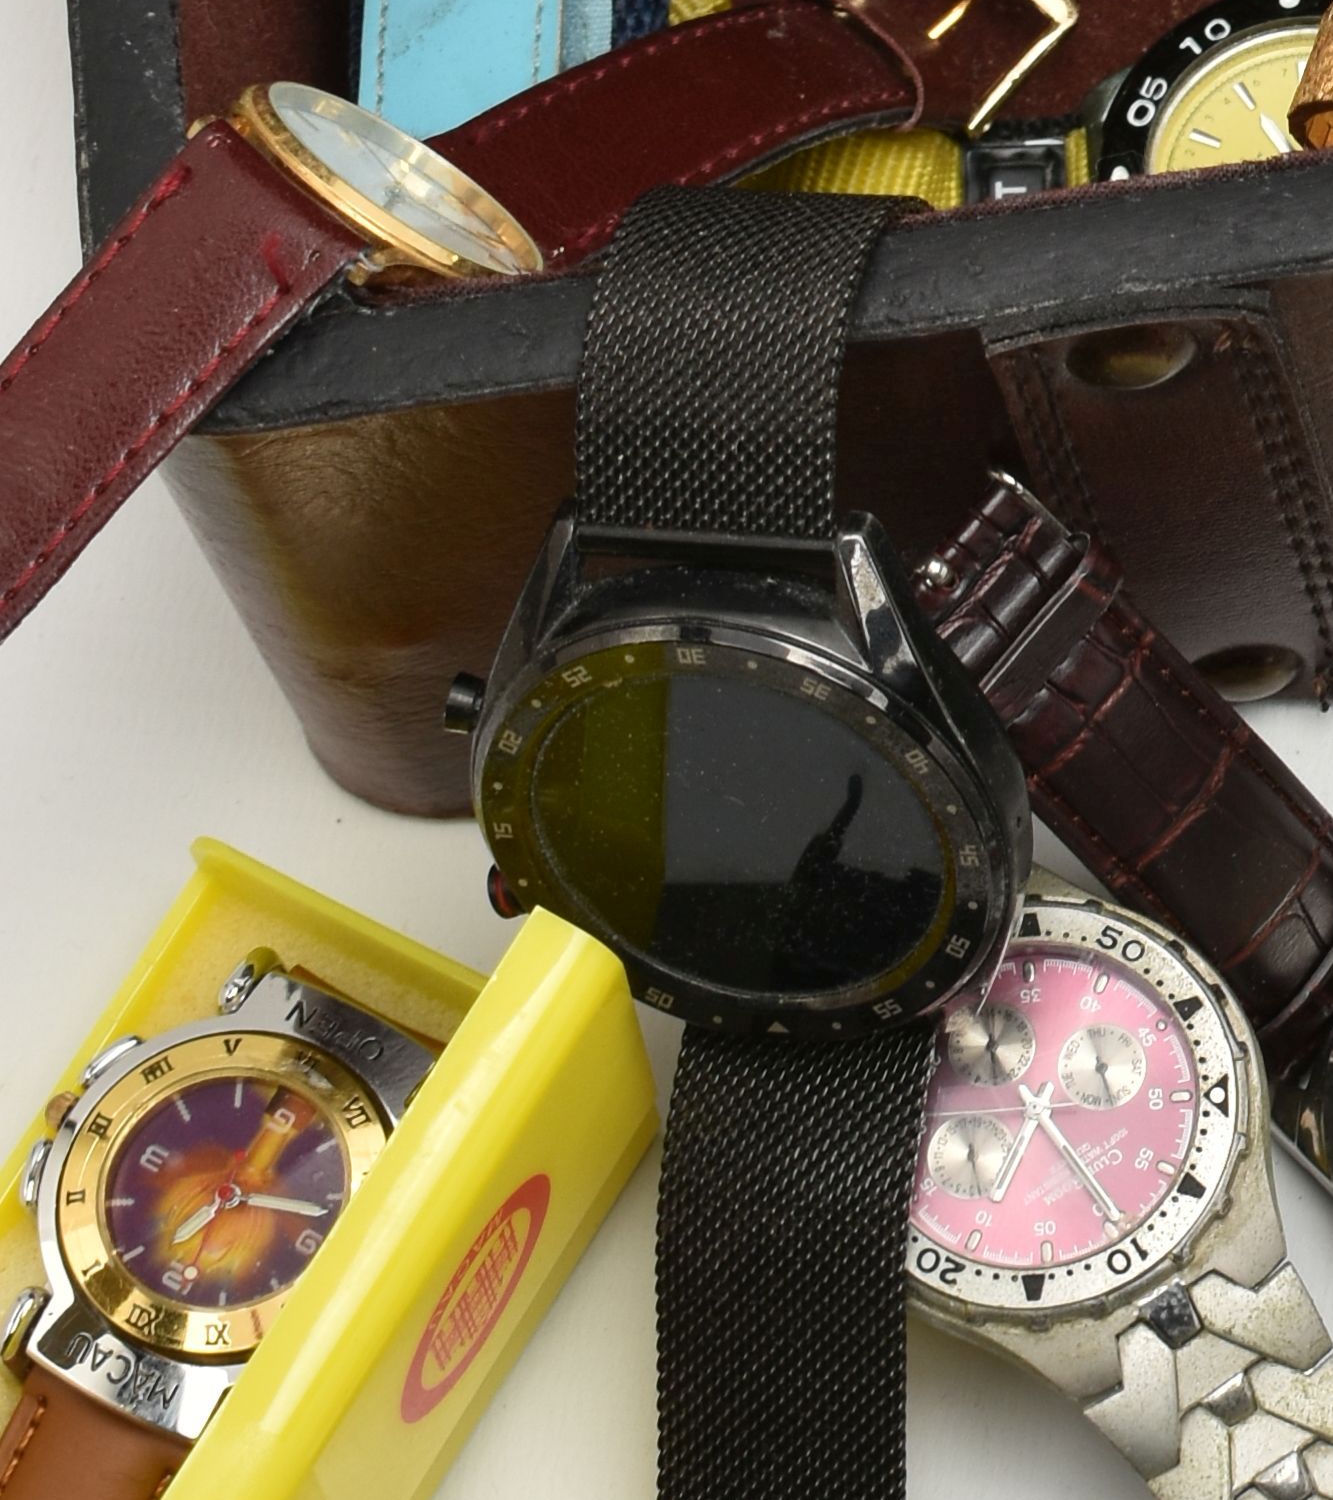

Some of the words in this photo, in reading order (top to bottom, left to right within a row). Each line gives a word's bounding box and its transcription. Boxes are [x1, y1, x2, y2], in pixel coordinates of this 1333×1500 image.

[1179, 18, 1231, 55] 10
[1126, 75, 1168, 127] 05
[676, 646, 707, 665] 30
[562, 664, 592, 688] 25
[801, 678, 832, 702] 35
[498, 729, 523, 755] 20
[905, 748, 931, 776] 40
[493, 821, 513, 840] 15
[947, 935, 971, 958] 50
[1096, 925, 1147, 963] 50
[644, 987, 676, 1009] 05
[1019, 988, 1042, 1004] 35
[1079, 995, 1103, 1013] 40
[873, 998, 904, 1019] 55
[285, 999, 385, 1062] OPEN
[1136, 1026, 1157, 1048] 45
[1148, 1088, 1164, 1111] 50
[1134, 1147, 1156, 1172] 55
[918, 1177, 936, 1197] 15
[974, 1210, 993, 1227] 10
[1033, 1220, 1057, 1237] 05
[916, 1246, 965, 1286] 20
[1106, 1237, 1151, 1274] 10
[68, 1331, 179, 1410] MACAU
